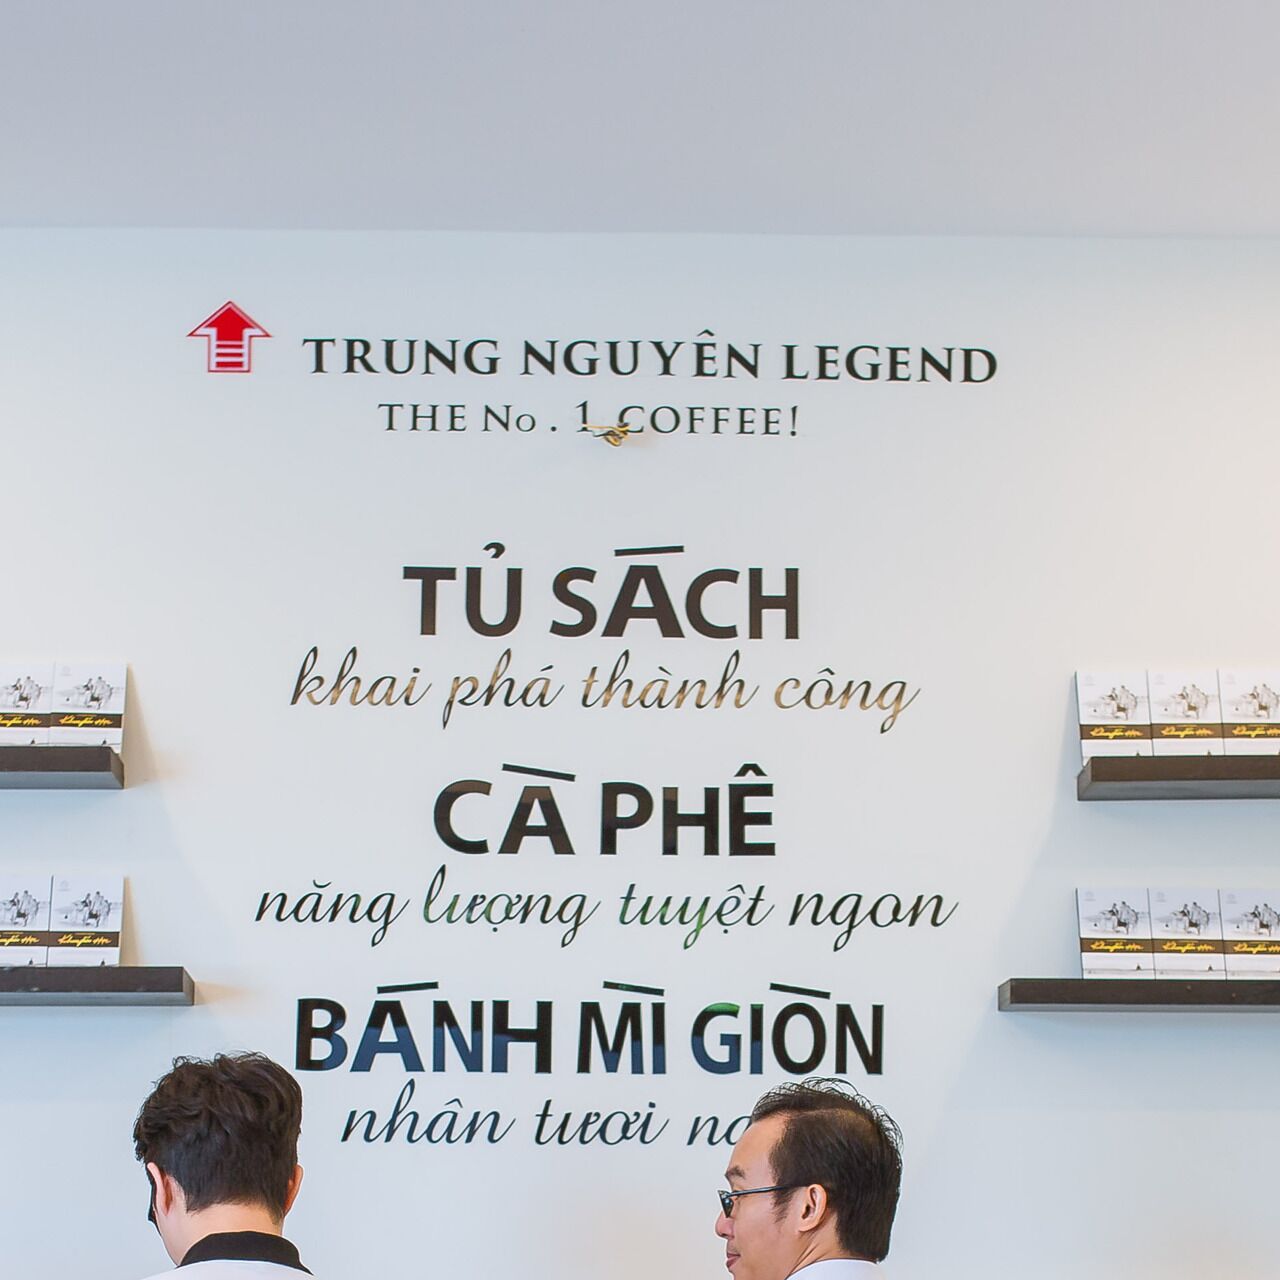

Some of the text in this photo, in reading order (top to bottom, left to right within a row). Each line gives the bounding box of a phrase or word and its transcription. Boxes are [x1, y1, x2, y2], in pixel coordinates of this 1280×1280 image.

[302, 329, 999, 385] TRUNG NGUYÊN LEGEND
[377, 403, 467, 433] THE
[617, 404, 798, 437] COFFEE!
[402, 541, 800, 640] TỦ SÁCH
[290, 646, 922, 735] khai phá thành công
[433, 763, 776, 857] CÀ PHÊ
[255, 863, 959, 953] năng lượng tuyệt ngon
[295, 980, 885, 1076] BÁNH MÌ GIÒN
[340, 1079, 516, 1144] nhân
[534, 1098, 670, 1147] tươi
